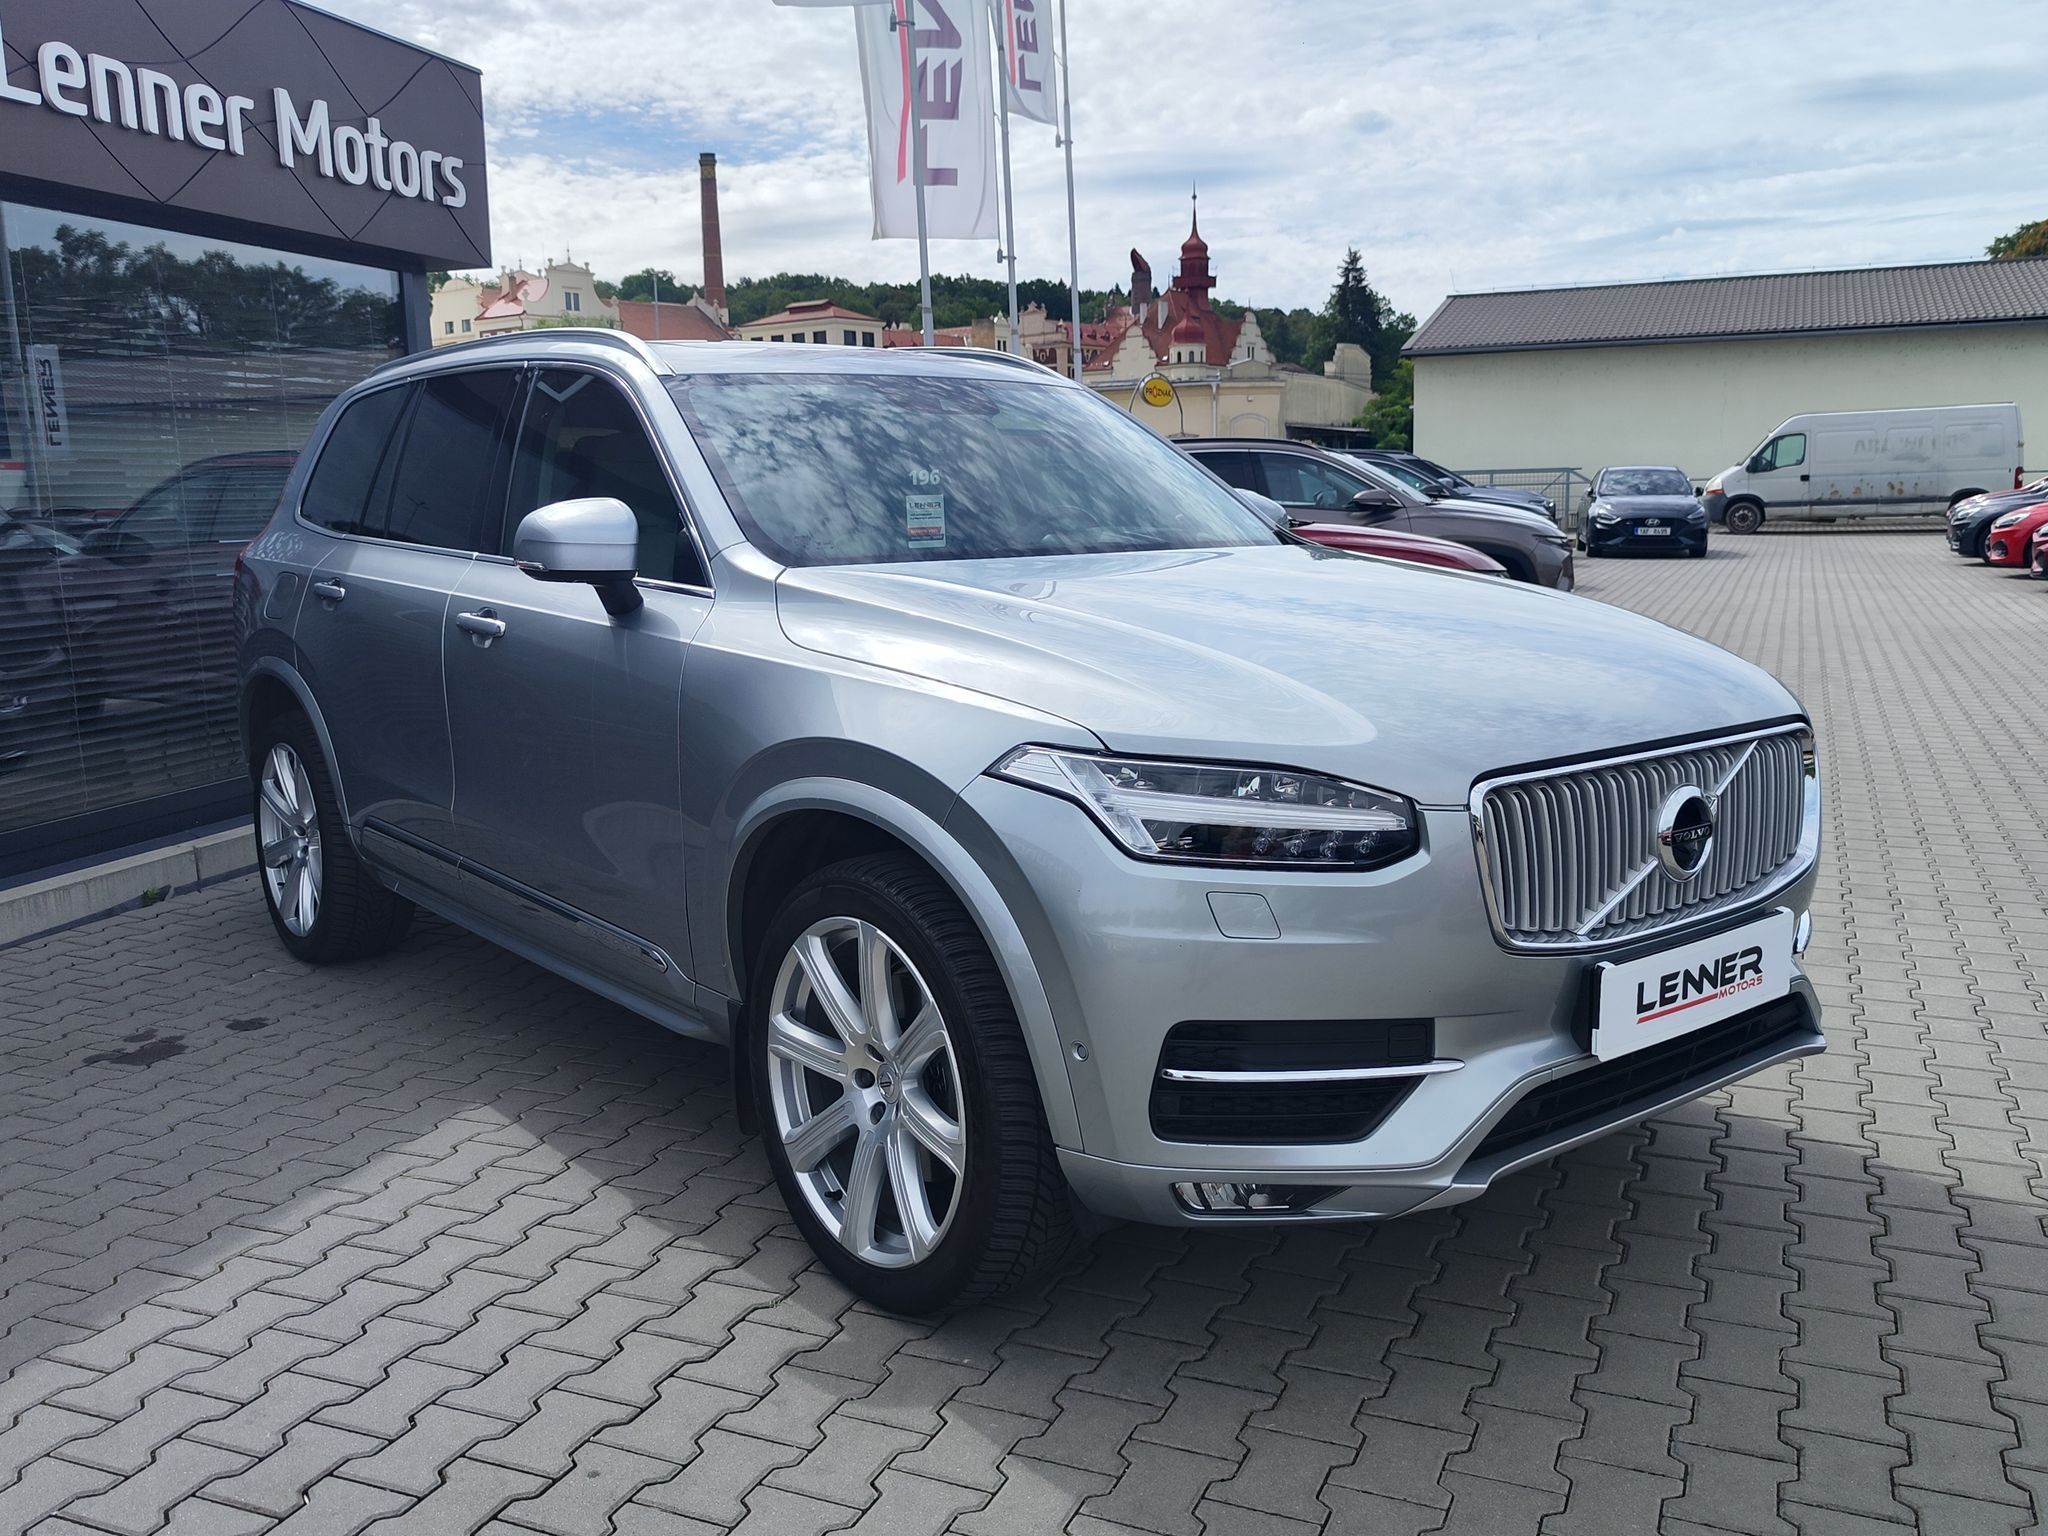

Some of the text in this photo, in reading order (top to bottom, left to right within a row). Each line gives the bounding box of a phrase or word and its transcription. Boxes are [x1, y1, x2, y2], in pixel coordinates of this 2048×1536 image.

[0, 21, 467, 208] Lenner Motors
[909, 469, 941, 486] 196
[1674, 825, 1710, 842] VOLVO
[1636, 945, 1764, 1015] LENNER
[1718, 975, 1763, 1000] MOTORS
